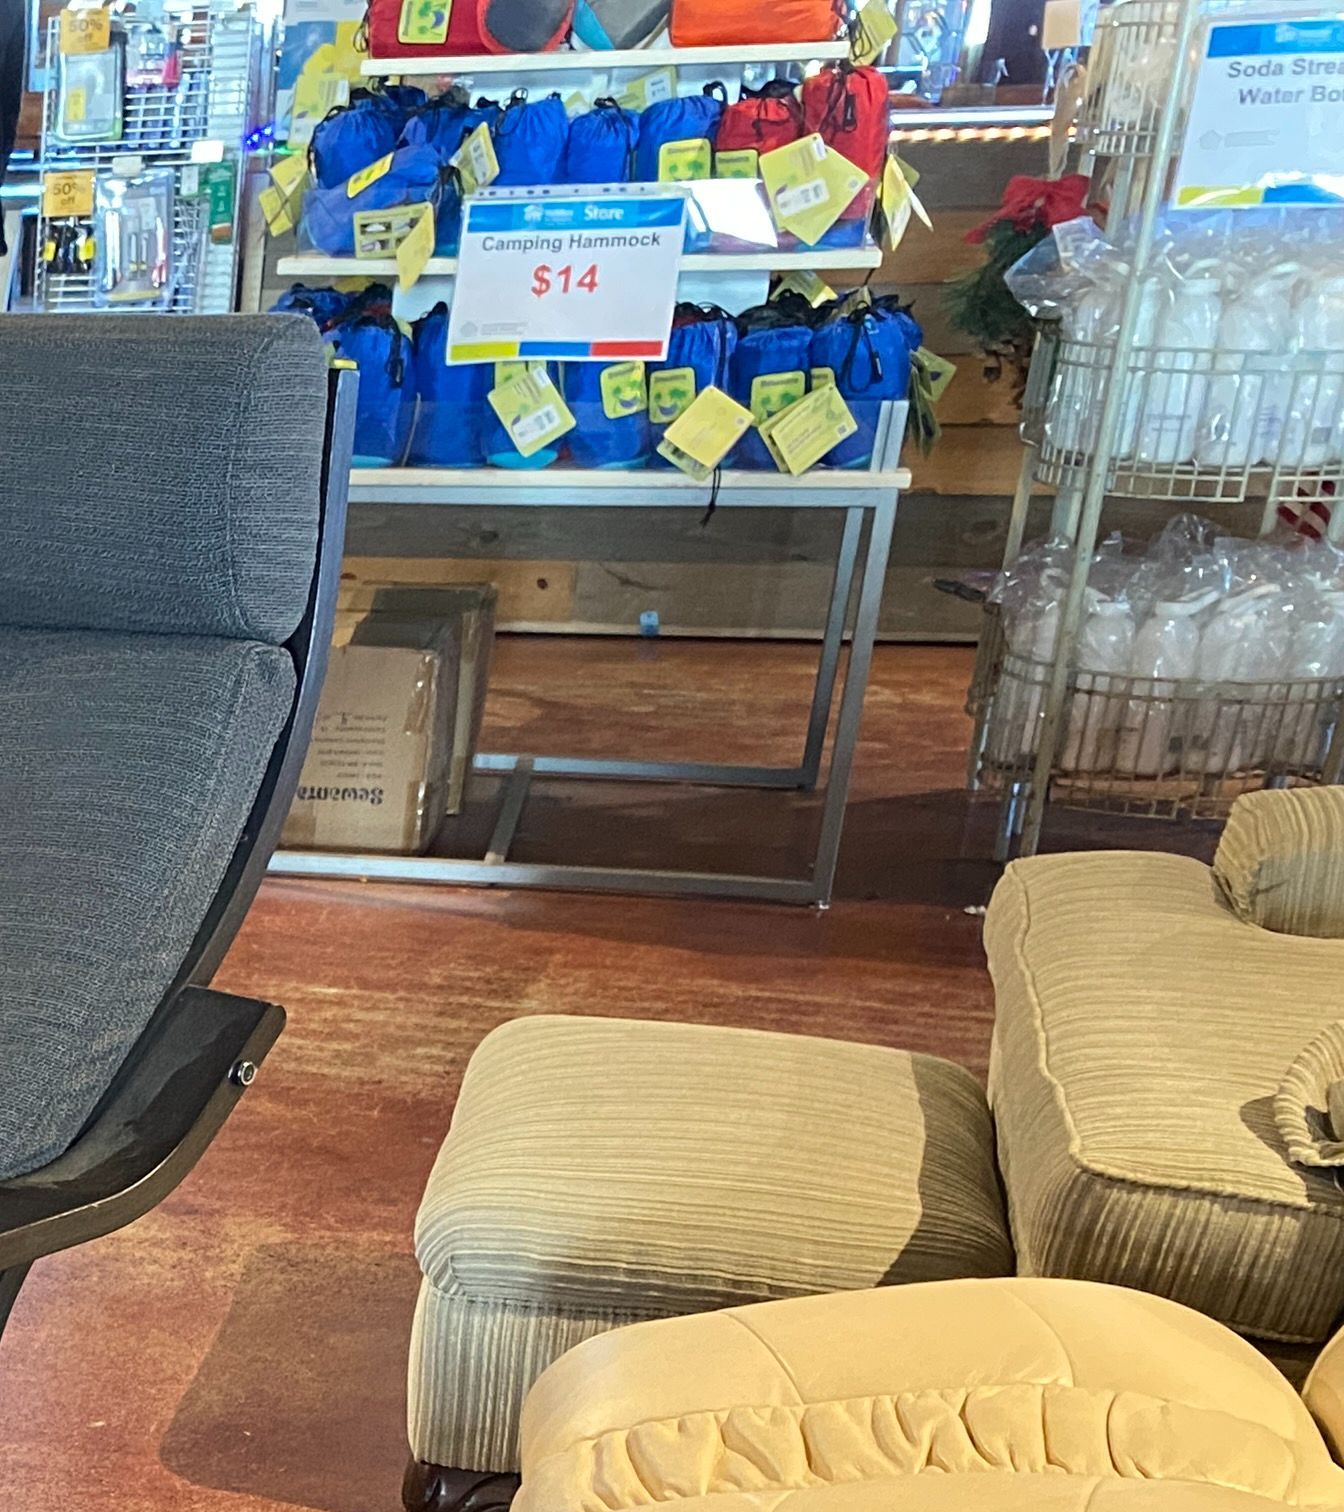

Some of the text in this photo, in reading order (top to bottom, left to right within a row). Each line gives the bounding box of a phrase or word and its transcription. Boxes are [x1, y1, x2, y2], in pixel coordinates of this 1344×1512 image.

[1228, 60, 1283, 78] Soda
[1239, 88, 1304, 104] Water
[584, 205, 624, 221] Store
[482, 232, 660, 253] Camping Hammock
[532, 264, 599, 297] $14
